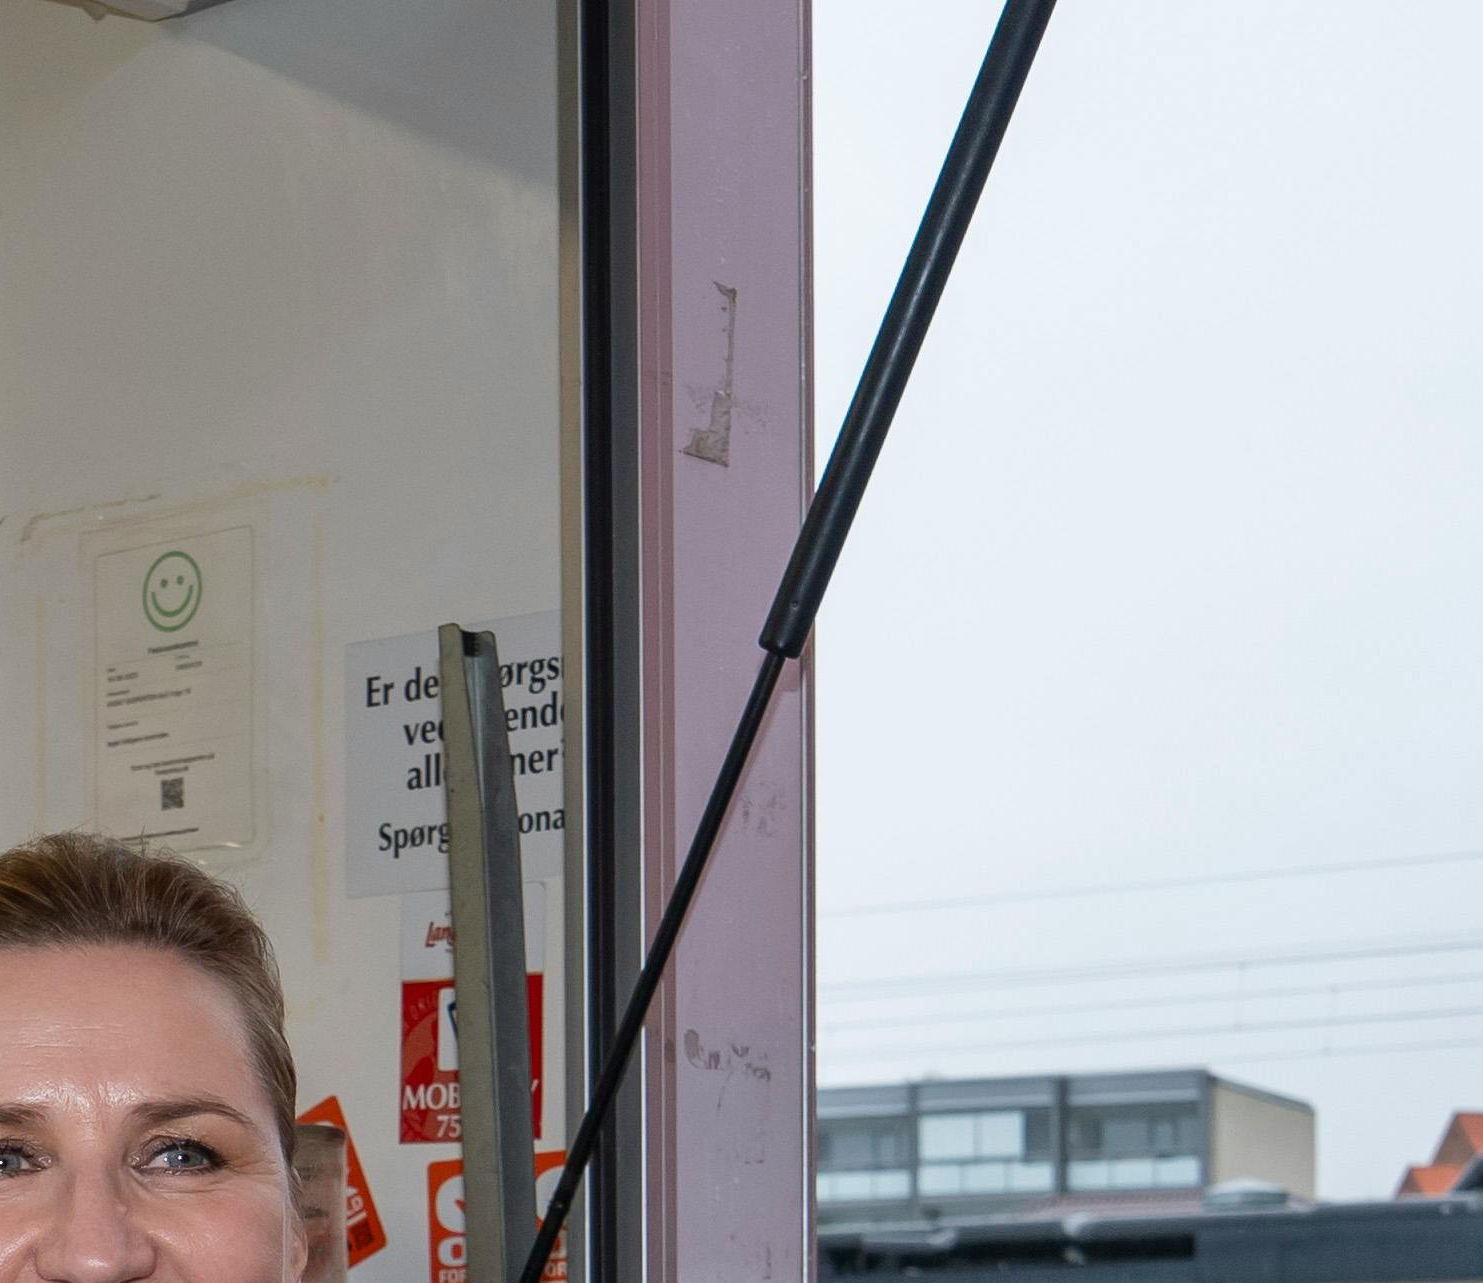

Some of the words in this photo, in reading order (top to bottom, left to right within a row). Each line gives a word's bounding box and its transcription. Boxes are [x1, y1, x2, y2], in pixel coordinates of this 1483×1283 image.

[366, 675, 395, 708] Er
[404, 666, 439, 703] de
[499, 655, 564, 695] ørgs
[406, 752, 446, 791] all
[511, 744, 564, 777] ner
[518, 808, 566, 835] ona
[402, 1083, 461, 1111] MOB
[437, 1115, 461, 1139] 75
